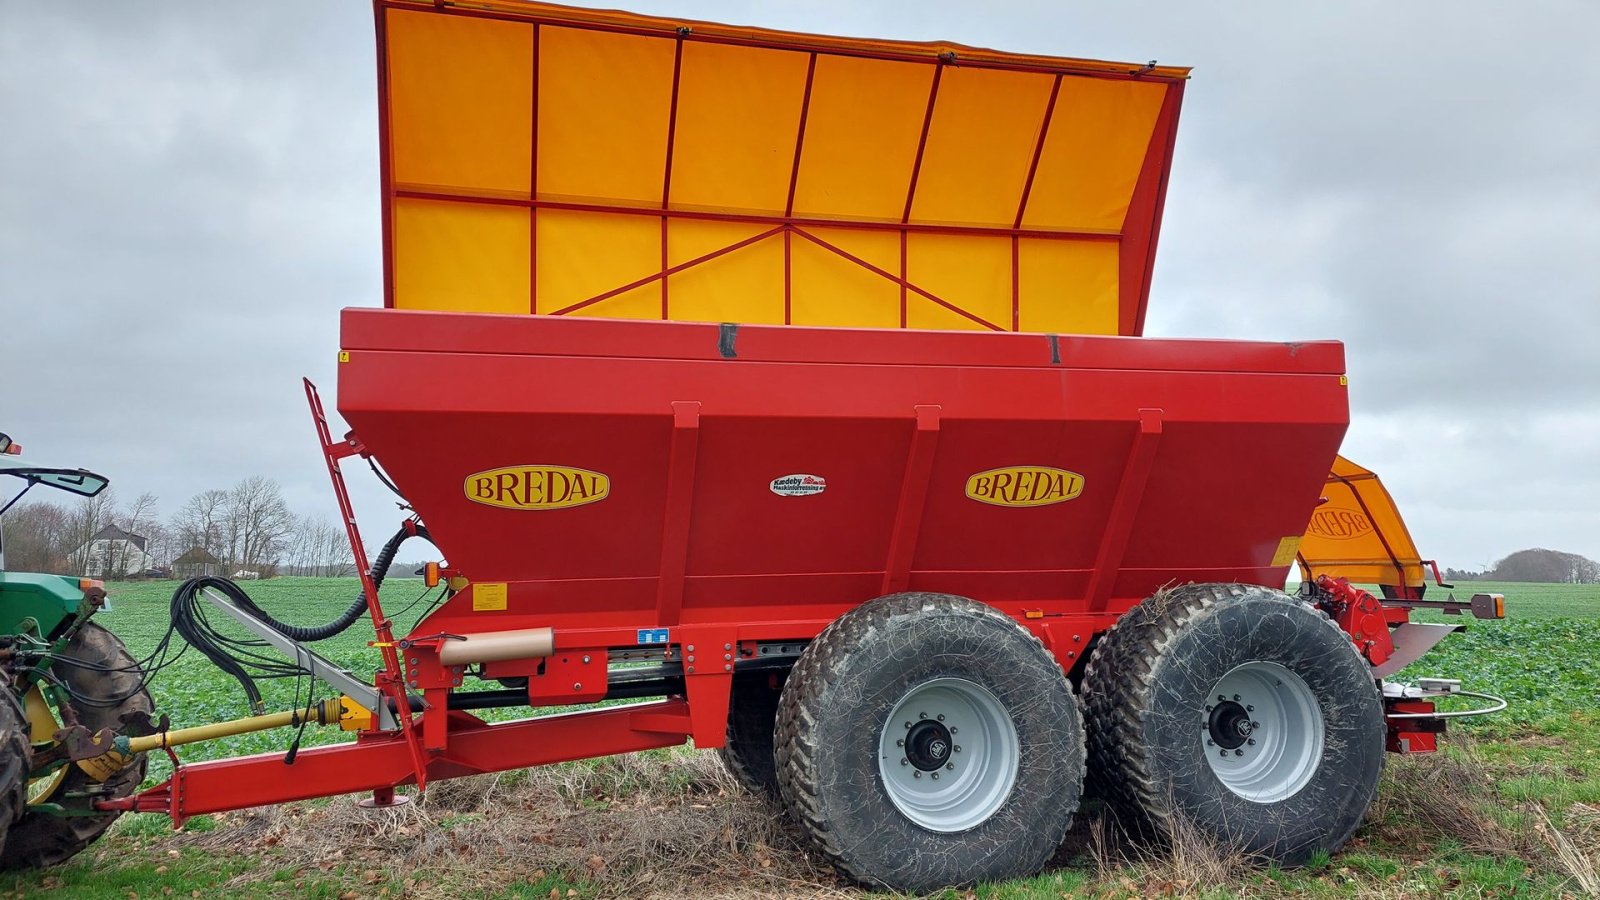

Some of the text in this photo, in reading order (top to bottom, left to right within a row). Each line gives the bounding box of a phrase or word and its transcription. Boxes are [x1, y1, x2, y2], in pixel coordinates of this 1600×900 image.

[475, 471, 604, 505] BREDAL
[774, 477, 802, 486] Kædeby
[973, 471, 1079, 503] BREDAL
